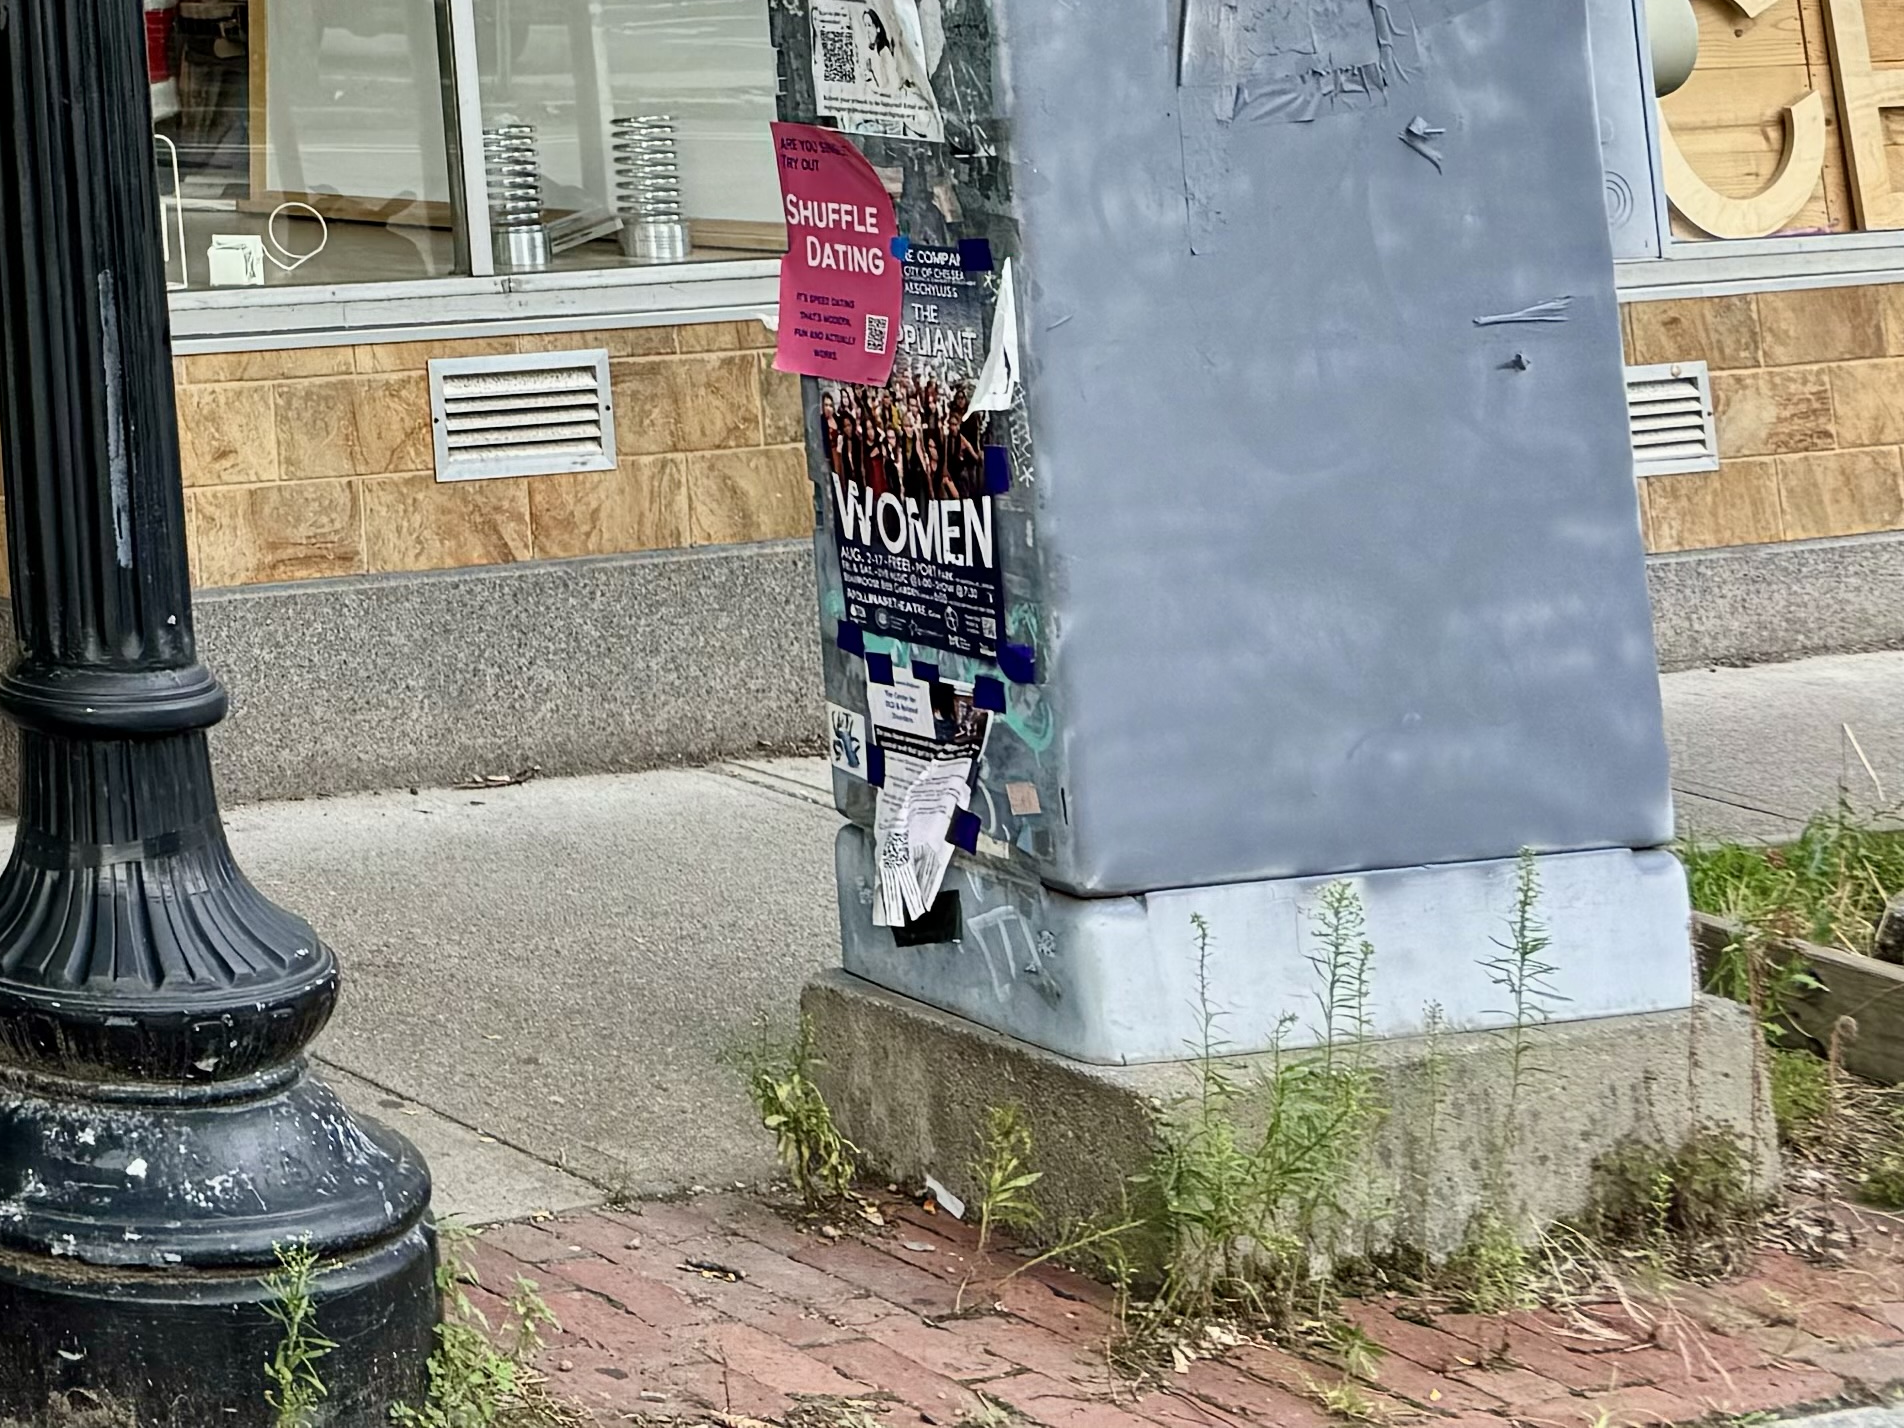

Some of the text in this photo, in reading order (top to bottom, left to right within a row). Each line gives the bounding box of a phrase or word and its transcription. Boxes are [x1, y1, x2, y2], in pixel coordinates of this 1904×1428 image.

[786, 193, 880, 235] SHUFFLE
[806, 235, 885, 276] DATING
[916, 250, 961, 267] COMPA
[912, 303, 939, 324] THE
[831, 471, 993, 569] WOMEN
